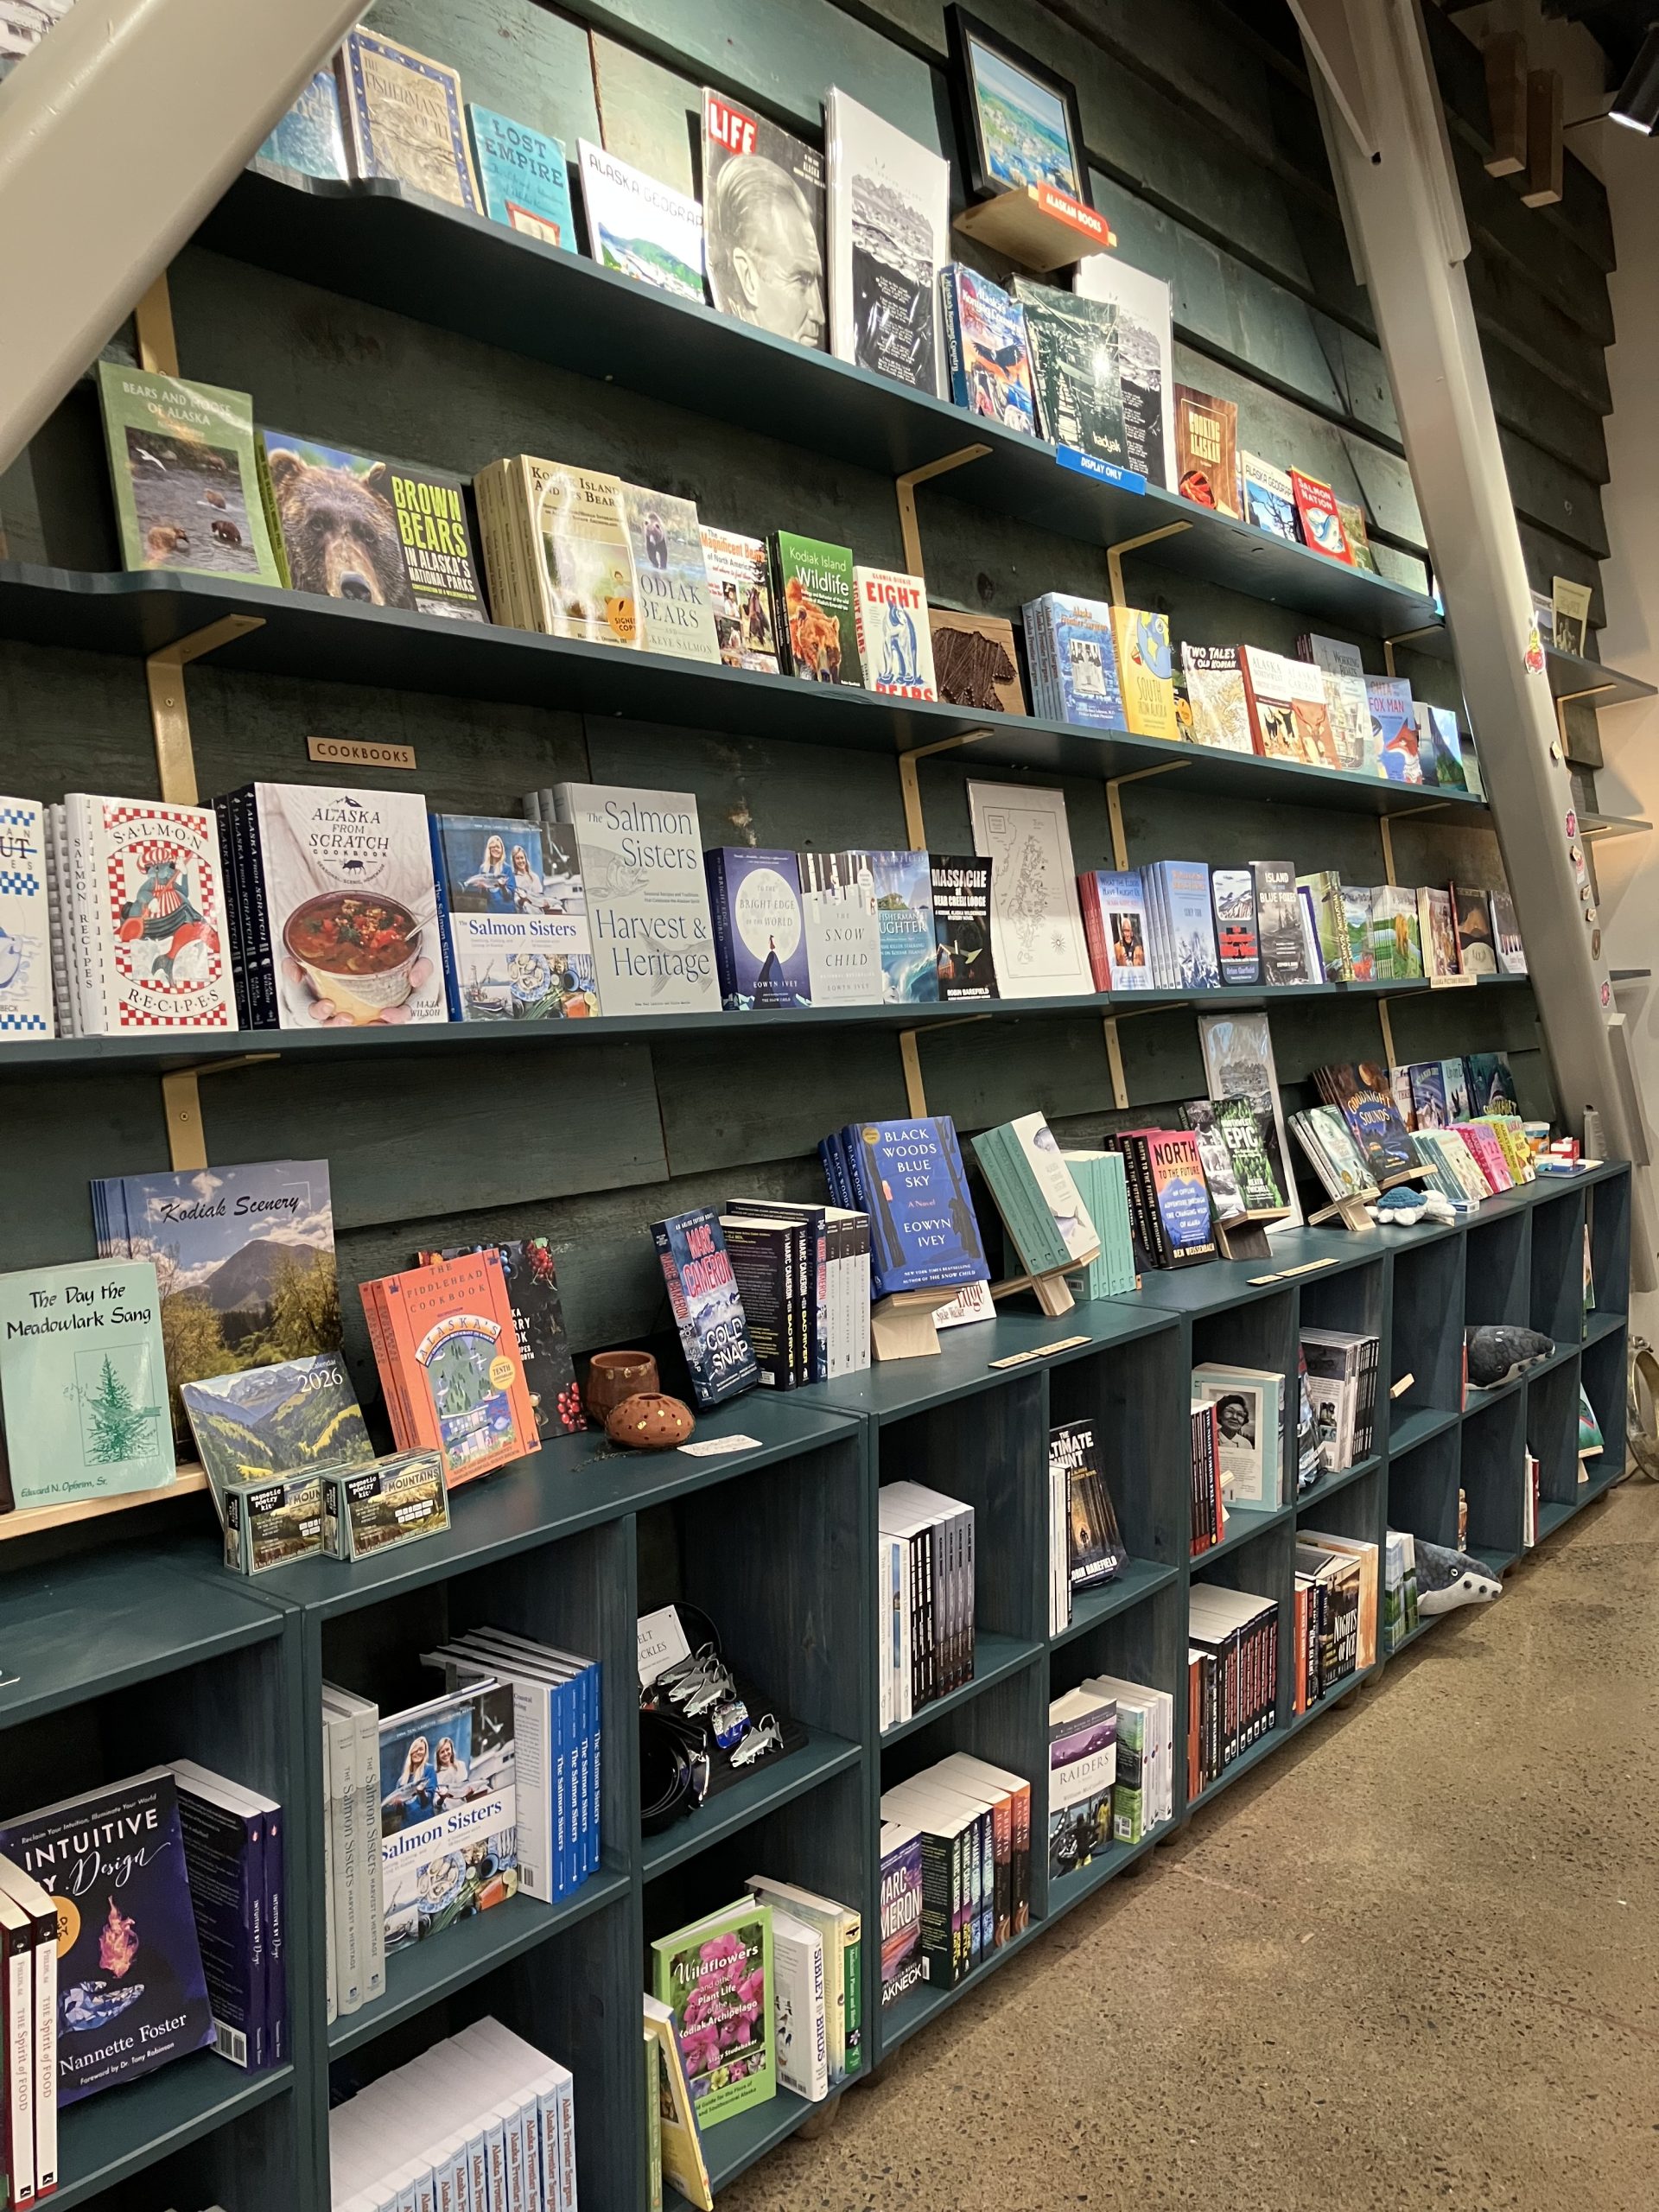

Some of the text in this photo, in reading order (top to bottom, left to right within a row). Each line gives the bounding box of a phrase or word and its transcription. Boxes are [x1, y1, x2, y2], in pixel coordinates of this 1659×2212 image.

[493, 118, 547, 160] LOST
[710, 102, 756, 154] LIFE
[485, 138, 564, 189] EMPIRE
[589, 153, 640, 194] ALASKA
[1046, 193, 1102, 233] ALASKAN BOOKS
[123, 381, 187, 408] BEARS AND
[168, 408, 211, 428] ALASKA
[1092, 430, 1122, 454] kadyak
[1081, 455, 1122, 481] DISPLAY ONLY
[1245, 464, 1268, 486] ALASKA
[391, 475, 462, 523] BROWN
[1297, 477, 1332, 500] SALMON
[1300, 490, 1333, 512] NATION
[397, 509, 468, 559] BEARS
[701, 531, 743, 556] Magnificent
[404, 546, 471, 580] IN ALASKA'S
[789, 546, 847, 572] Kodiak Island
[410, 566, 448, 590] NATIONAL
[448, 572, 475, 594] PARKS
[640, 573, 703, 606] ODIAK
[795, 564, 850, 597] Wildlife
[866, 581, 920, 610] EIGHT
[1186, 645, 1236, 660] TWO TALES
[1137, 677, 1163, 703] SOUTH
[1369, 697, 1404, 714] FOX MAN
[316, 742, 410, 763] COOKBOOKS
[310, 808, 382, 825] ALASKA
[332, 823, 365, 835] FROM
[587, 800, 693, 836] The Salmon
[245, 809, 259, 856] ALASKA
[308, 832, 391, 850] SCRATCH
[313, 849, 389, 858] COOKBOOK
[621, 837, 698, 870] Sisters
[931, 868, 988, 888] MASSACRE
[1264, 872, 1289, 883] ISLAND
[739, 898, 796, 911] BRIGHT EDGE
[934, 895, 987, 907] BEAR LODGE
[1259, 893, 1278, 903] BLUE
[73, 837, 94, 989] SALMON RECIPES
[595, 909, 708, 940] Harvest &
[764, 917, 794, 928] WORLD
[469, 918, 577, 937] Salmon Sisters
[824, 927, 866, 943] SNOW
[441, 940, 451, 976] Sisters
[612, 947, 711, 983] Heritage
[825, 953, 868, 968] CHILD
[1347, 1090, 1392, 1116] GOODNIGHT
[1358, 1109, 1391, 1127] SOUNDS
[884, 1128, 930, 1143] BLACK
[1224, 1125, 1259, 1149] EPIC
[882, 1142, 938, 1159] WOODS
[1153, 1140, 1198, 1166] NORTH
[847, 1144, 864, 1202] BLACK WOODS
[897, 1159, 932, 1173] BLUE
[1158, 1166, 1201, 1179] TO THE FUTURE
[833, 1152, 850, 1209] BLACK WOODS
[905, 1175, 931, 1189] SKY
[160, 1192, 301, 1224] Kodiak Scenery
[914, 1198, 937, 1208] Novel
[903, 1217, 952, 1234] EOWYN
[685, 1224, 715, 1260] MARC
[918, 1234, 946, 1248] IVEY
[1173, 1243, 1216, 1259] BEN WEISSENBACH
[429, 1262, 453, 1276] THE
[683, 1249, 733, 1299] CAMERON
[29, 1281, 126, 1309] The Day the
[406, 1269, 484, 1299] FIDDLEHEAD
[659, 1251, 690, 1321] MARC CAMERON
[785, 1265, 794, 1300] CAMERON
[410, 1283, 486, 1313] COOKBOOK
[6, 1306, 152, 1340] Meadowlark Sang
[706, 1318, 744, 1351] COLD
[419, 1316, 499, 1360] ALASKA'S
[309, 1358, 337, 1370] Calendar
[712, 1340, 749, 1372] SNAP
[296, 1369, 344, 1394] 2026
[492, 1363, 512, 1377] TENTH
[1059, 1430, 1070, 1440] THE
[348, 1475, 377, 1490] magnetic
[353, 1483, 374, 1495] poetry
[388, 1468, 440, 1492] MOUNTAINS
[251, 1488, 282, 1503] magnetic
[255, 1496, 278, 1509] poetry
[1085, 1554, 1119, 1578] BAREFIELD
[1333, 1607, 1358, 1644] NIGHTS
[1338, 1631, 1357, 1662] OF ICE
[1059, 1752, 1109, 1785] RAIDERS
[365, 1772, 376, 1828] Salmon
[21, 1793, 158, 1845] Reclaim Your World
[343, 1786, 354, 1841] Salmon
[447, 1800, 503, 1834] Sisters
[24, 1808, 159, 1872] INTUITIVE
[365, 1827, 377, 1878] Sisters
[65, 1841, 172, 1897] Design
[344, 1840, 354, 1890] Sisters
[674, 1944, 760, 1986] Wildflowers
[696, 1983, 737, 2005] Plant Life
[813, 1948, 826, 2063] SIBLEY BIRDS
[707, 1999, 759, 2029] Archipelago
[60, 2012, 188, 2077] Nannette Foster
[15, 2030, 29, 2113] Spirit FOOD
[41, 2018, 53, 2099] Spirit FOOD
[79, 2052, 146, 2086] Foreword Tony
[701, 2098, 716, 2108] Guide
[709, 2087, 757, 2113] Southcentral Alaska
